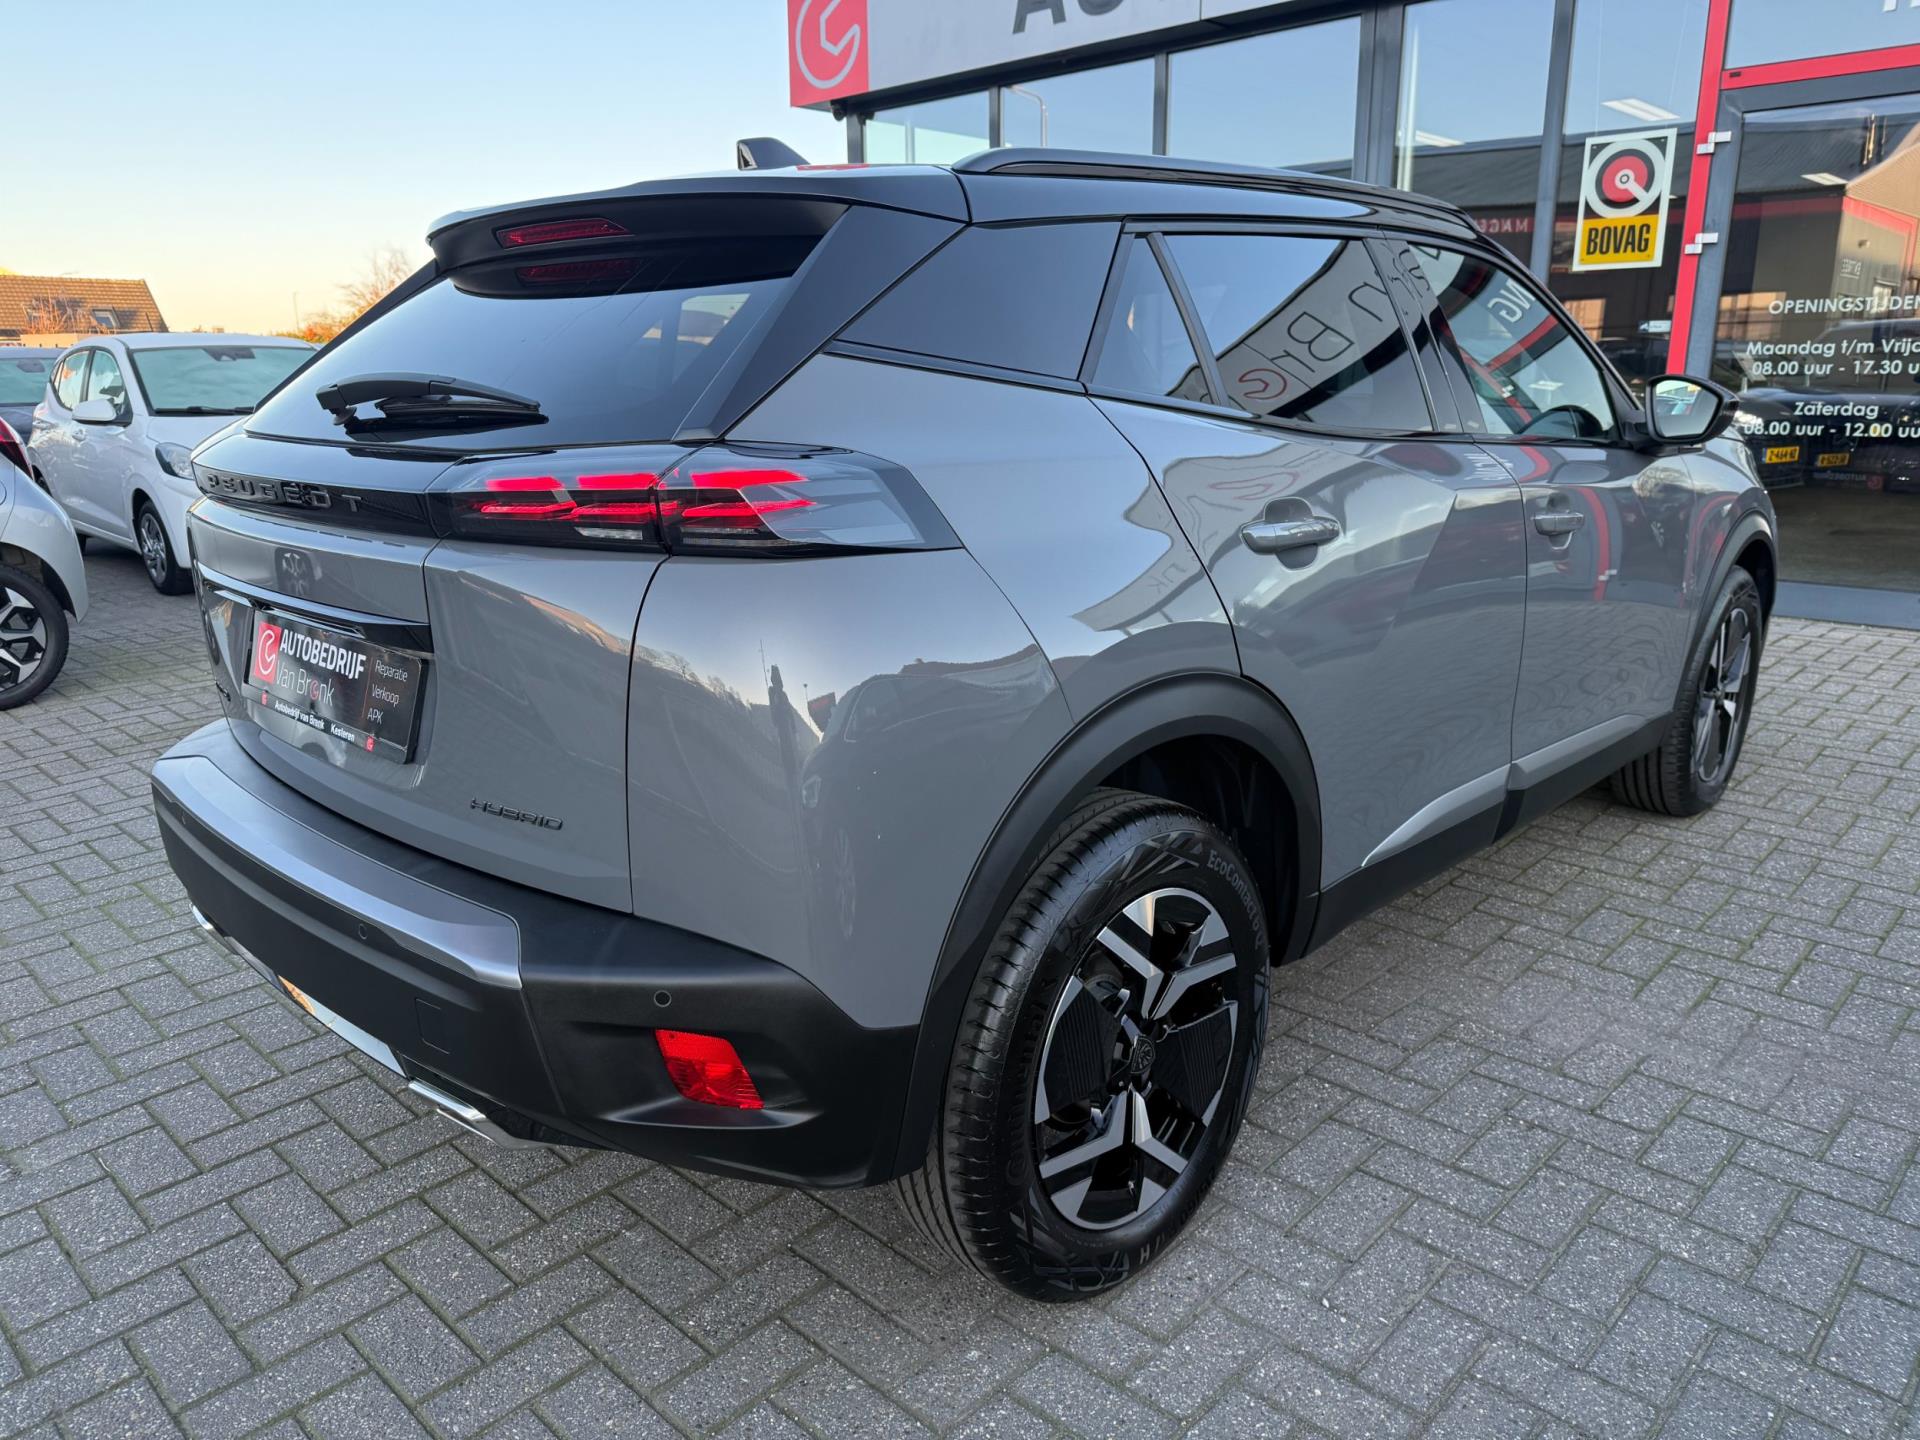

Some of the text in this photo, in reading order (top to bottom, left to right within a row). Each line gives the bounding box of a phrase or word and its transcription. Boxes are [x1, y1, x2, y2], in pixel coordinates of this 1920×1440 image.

[1586, 223, 1651, 256] BOVAG
[1746, 340, 1835, 358] Maandag
[1841, 339, 1875, 355] t/m
[1752, 361, 1799, 375] 08.00
[1803, 363, 1834, 375] uur
[1853, 360, 1902, 375] 17.30
[1793, 402, 1879, 419] Zaterdag
[1743, 421, 1790, 436] 08.00
[1795, 424, 1825, 436] uur
[1844, 423, 1893, 438] 12.00
[207, 474, 362, 513] PEUGEOT
[279, 629, 367, 679] AUTOBEDRIJF
[275, 660, 335, 706] Van Bronk
[375, 659, 408, 683] Reparatie
[371, 684, 400, 708] Verkoop
[367, 707, 384, 725] APK
[330, 723, 355, 742] Kesteren
[470, 798, 563, 830] HYBRID
